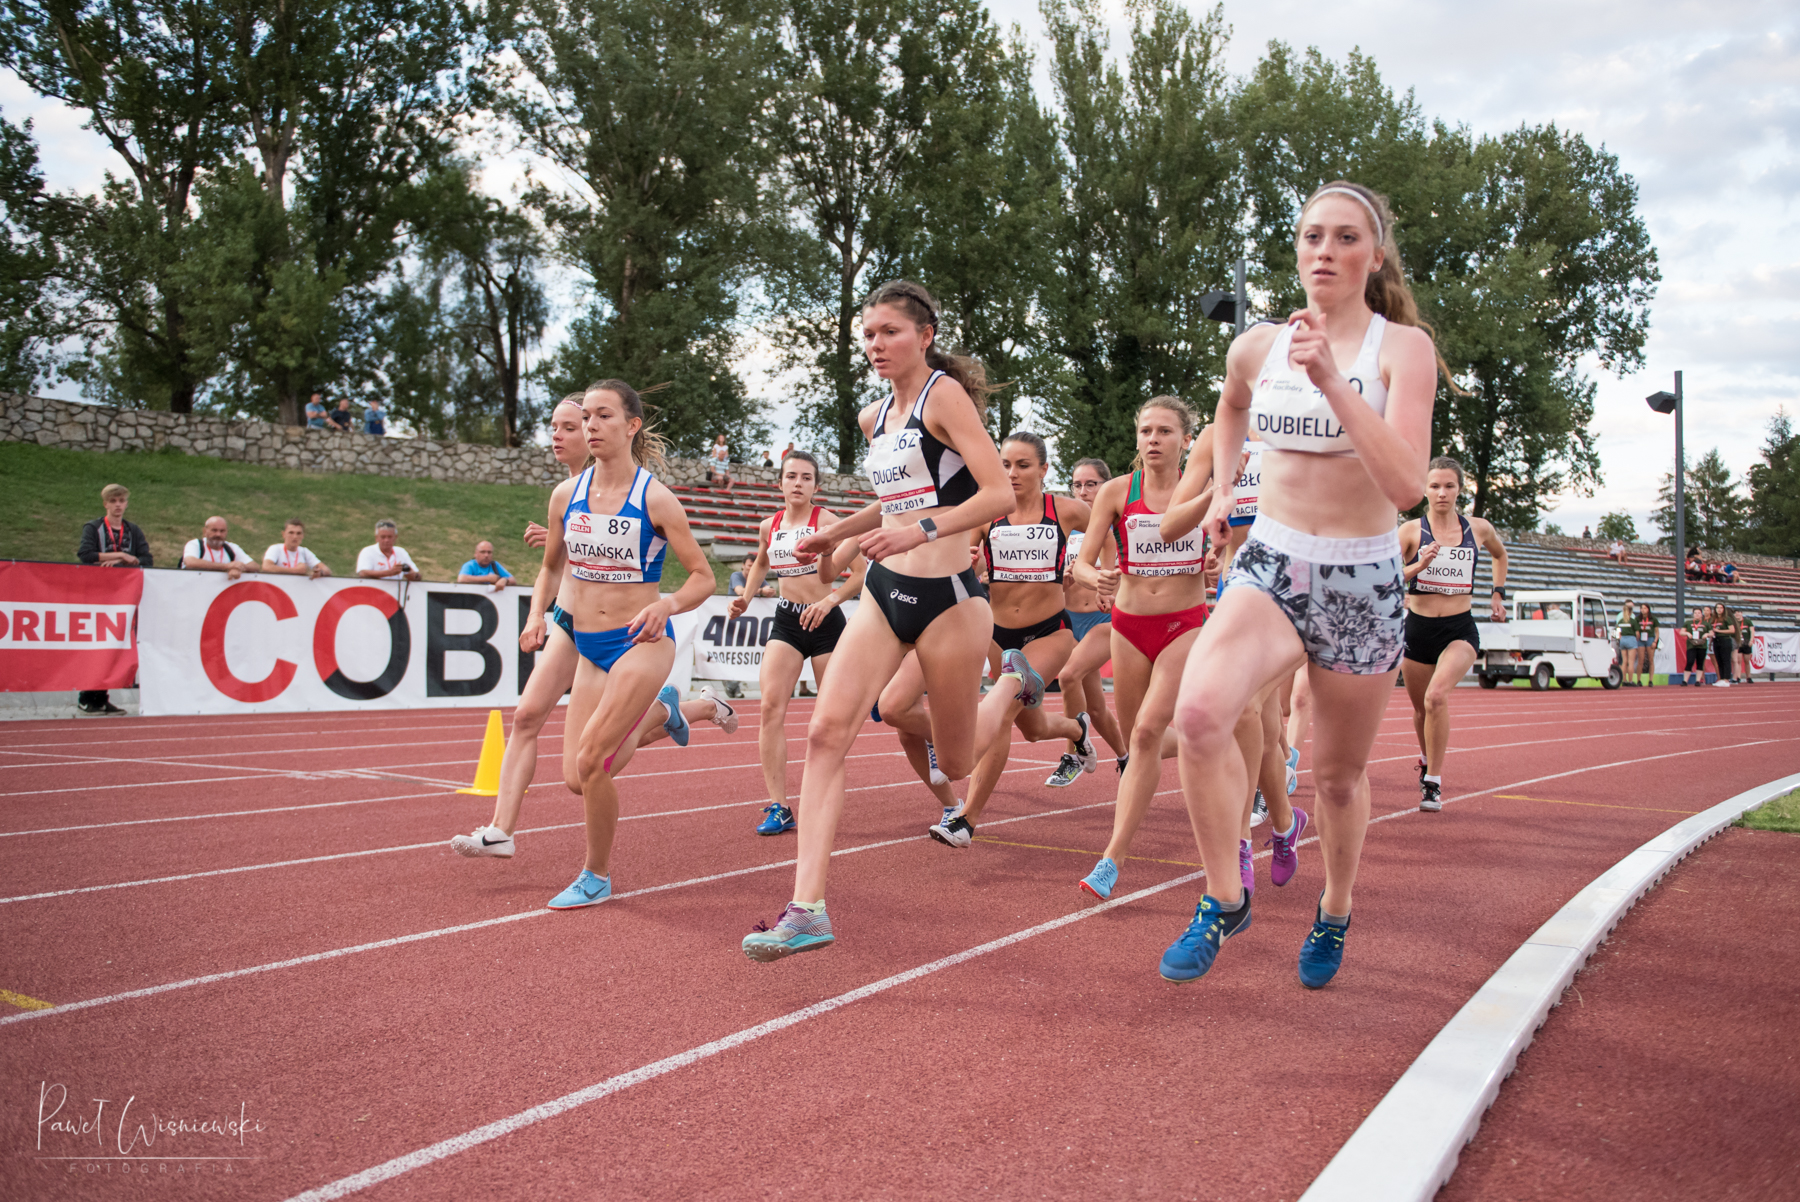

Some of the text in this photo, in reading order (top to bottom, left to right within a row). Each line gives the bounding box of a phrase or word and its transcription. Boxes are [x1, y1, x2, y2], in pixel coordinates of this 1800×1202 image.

[872, 464, 912, 486] DUDEK
[903, 497, 925, 510] 2019
[608, 518, 631, 536] 89
[1026, 526, 1055, 540] 370
[568, 540, 635, 561] LATAŃSKA
[1135, 540, 1195, 555] KARPIUK
[998, 549, 1050, 561] MATYSIK
[1449, 548, 1472, 561] 501
[576, 567, 632, 581] RACIBÓRZ 2019
[1000, 571, 1049, 581] RACIBÓRZ 2019
[1136, 566, 1195, 576] RACIBÓRZ 2019
[1426, 566, 1464, 578] SIKORA
[706, 651, 764, 666] PROFESSIO
[1767, 651, 1797, 663] Racibórz
